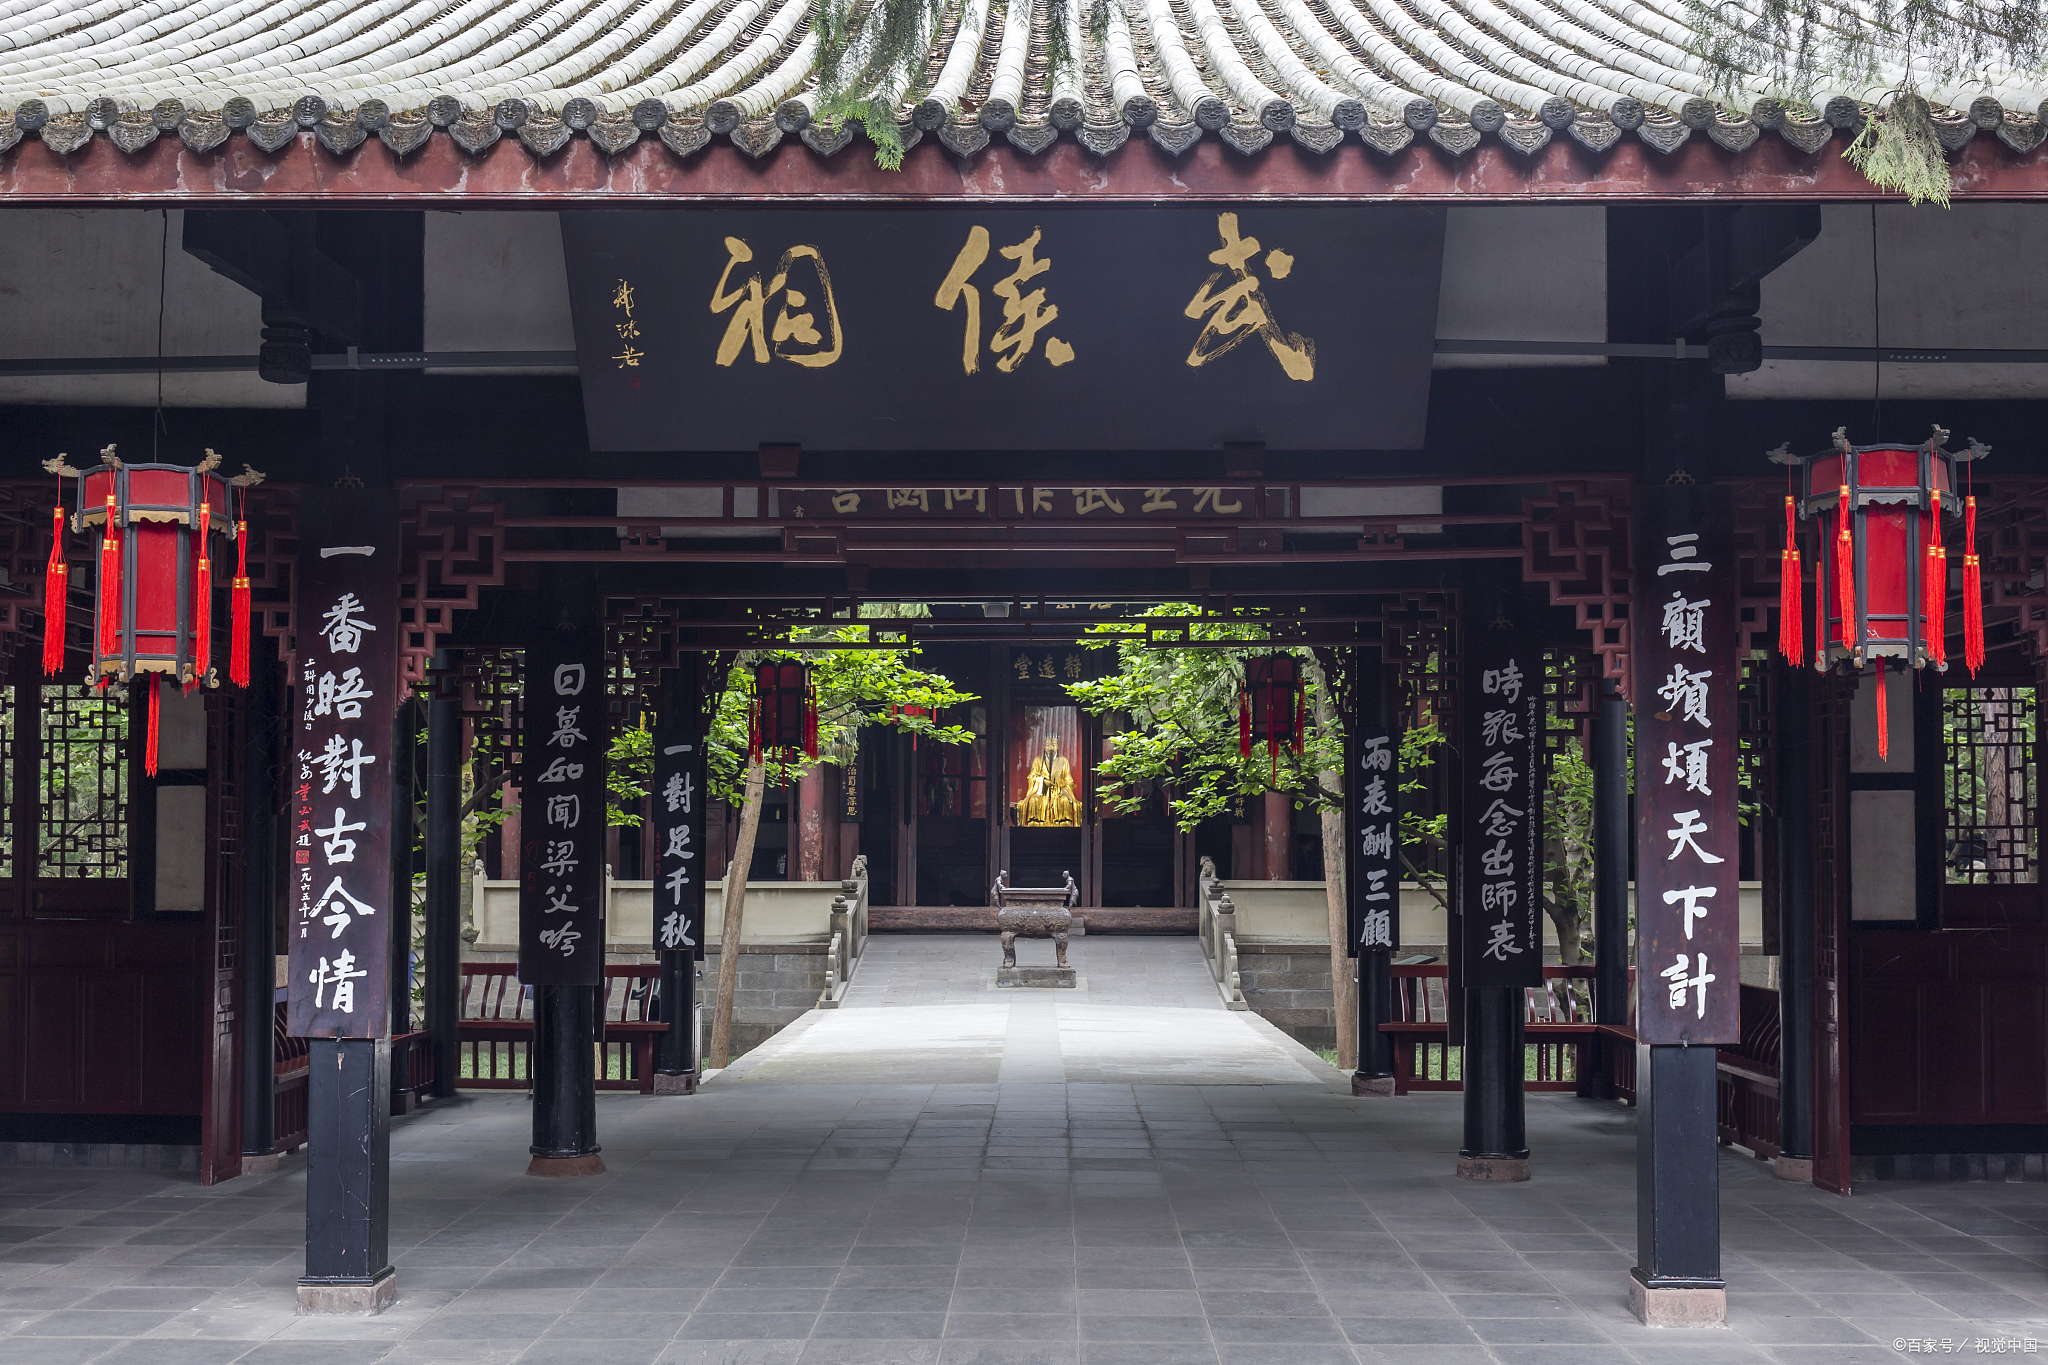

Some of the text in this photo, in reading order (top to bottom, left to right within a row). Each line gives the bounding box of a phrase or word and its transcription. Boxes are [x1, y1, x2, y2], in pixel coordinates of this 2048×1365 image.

[709, 212, 1316, 382] 武侯祠
[309, 546, 377, 1014] 一番晤對古今情
[660, 744, 696, 949] 一對足千秋
[1360, 736, 1394, 947] 兩表酬三顧
[1656, 533, 1724, 1020] 三顧頻煩天下計
